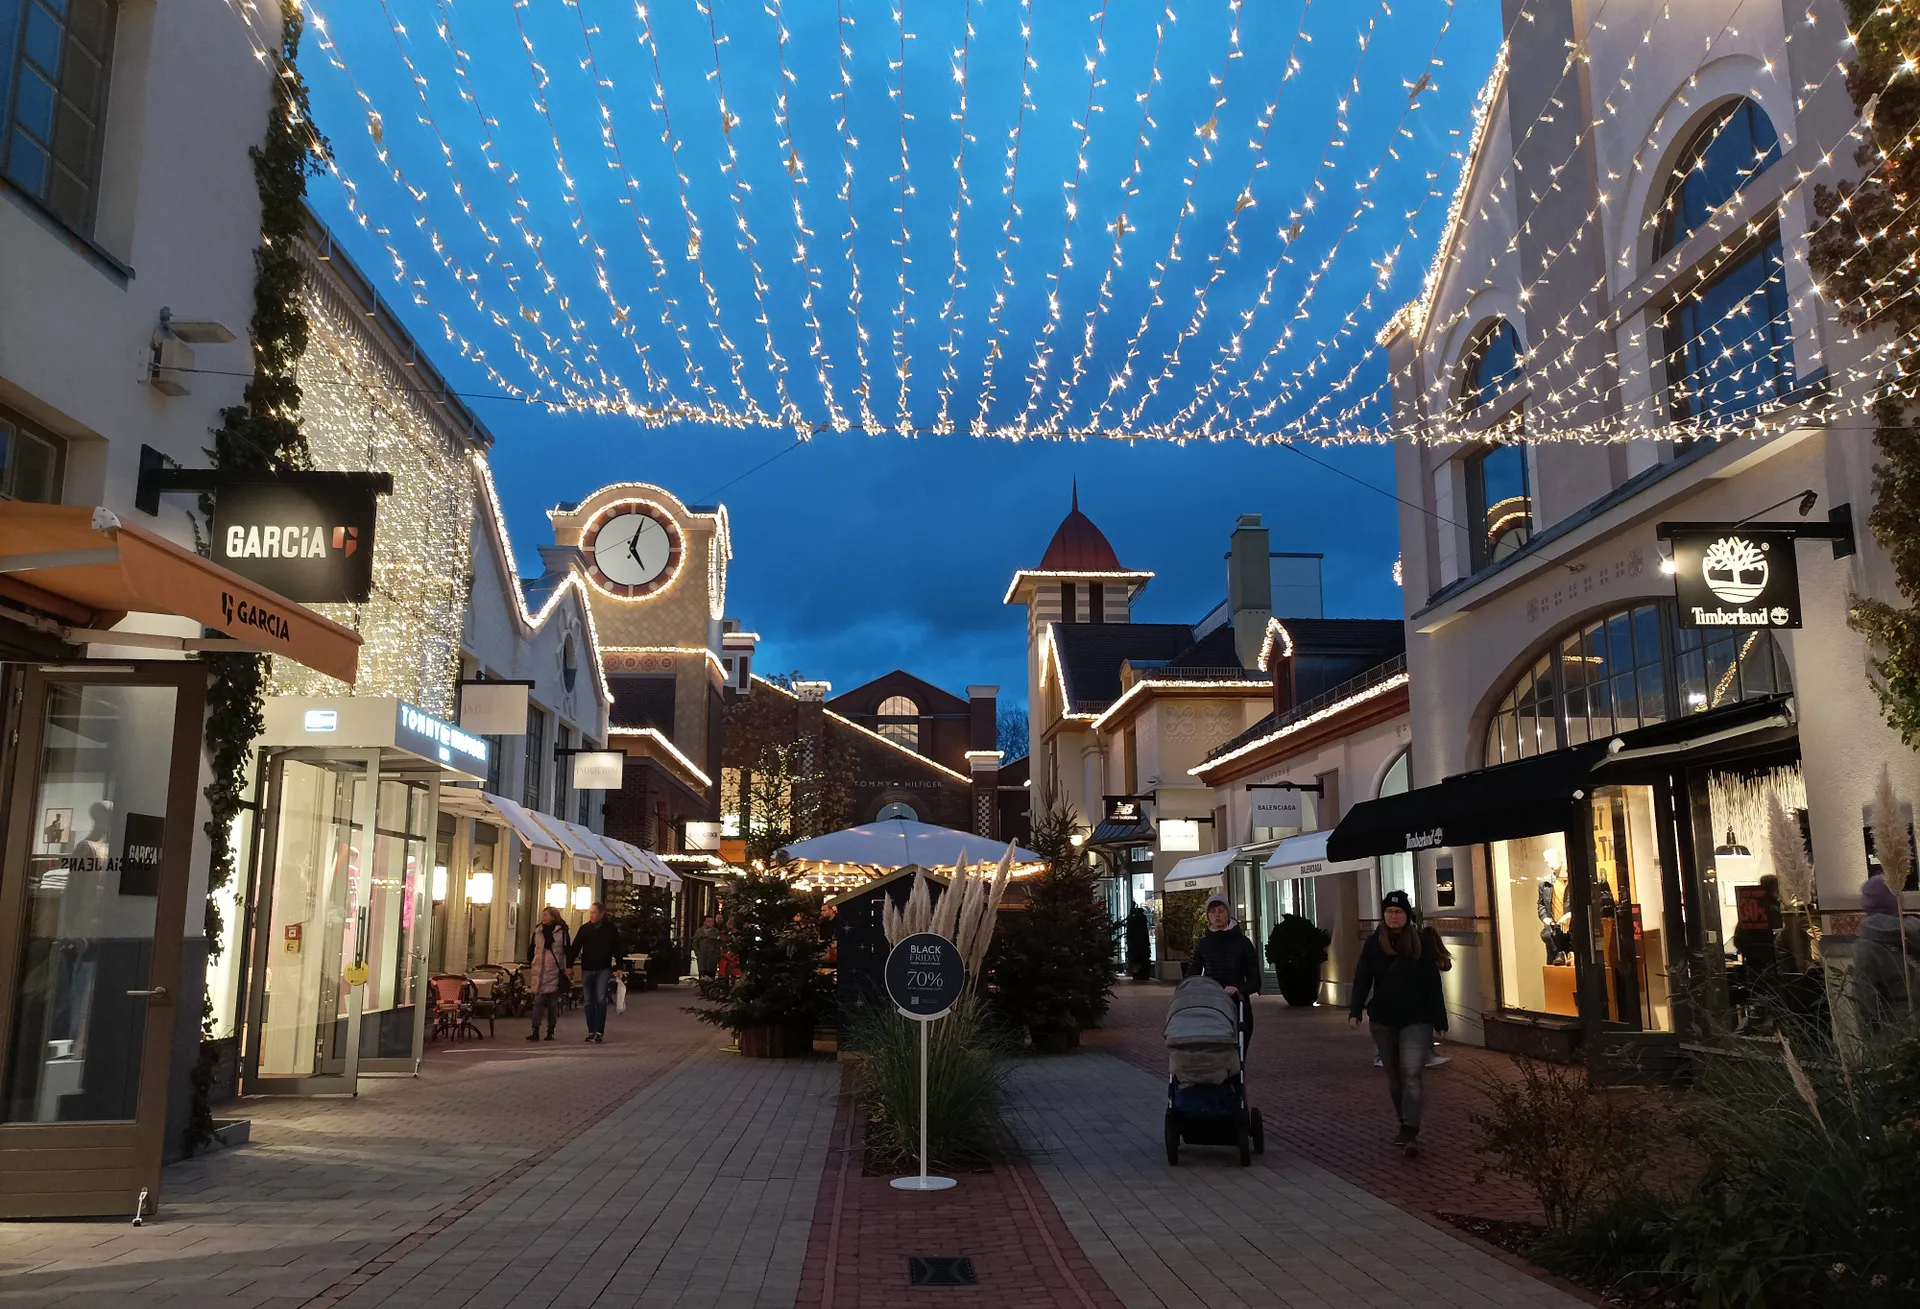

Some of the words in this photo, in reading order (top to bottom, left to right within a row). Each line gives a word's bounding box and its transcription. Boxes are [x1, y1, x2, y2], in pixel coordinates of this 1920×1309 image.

[237, 601, 290, 642] GARCIA
[1691, 606, 1769, 625] Timberland
[853, 780, 892, 788] TOMMY
[904, 780, 943, 788] HILFIGER
[910, 944, 941, 954] BLACK
[909, 953, 942, 962] FRIDAY
[907, 970, 944, 987] 70%
